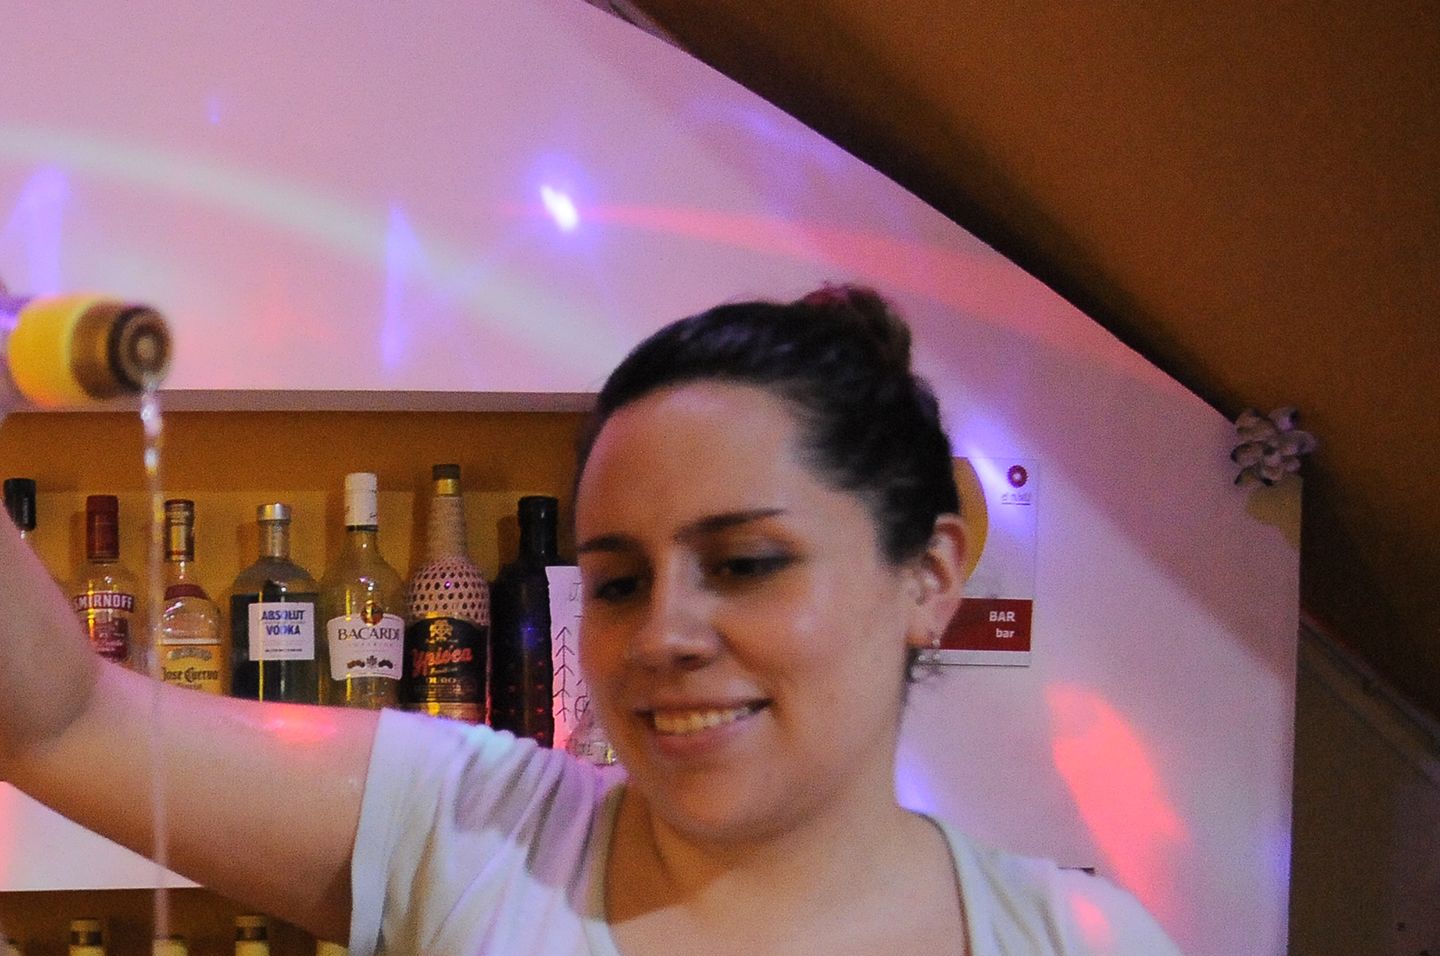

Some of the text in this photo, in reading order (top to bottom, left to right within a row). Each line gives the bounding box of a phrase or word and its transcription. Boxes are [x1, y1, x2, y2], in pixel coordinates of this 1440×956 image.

[262, 609, 306, 621] ABSOLUT
[989, 611, 1015, 622] BAR
[266, 624, 301, 636] VODKA
[338, 627, 400, 641] BACARDI
[996, 628, 1014, 638] bar
